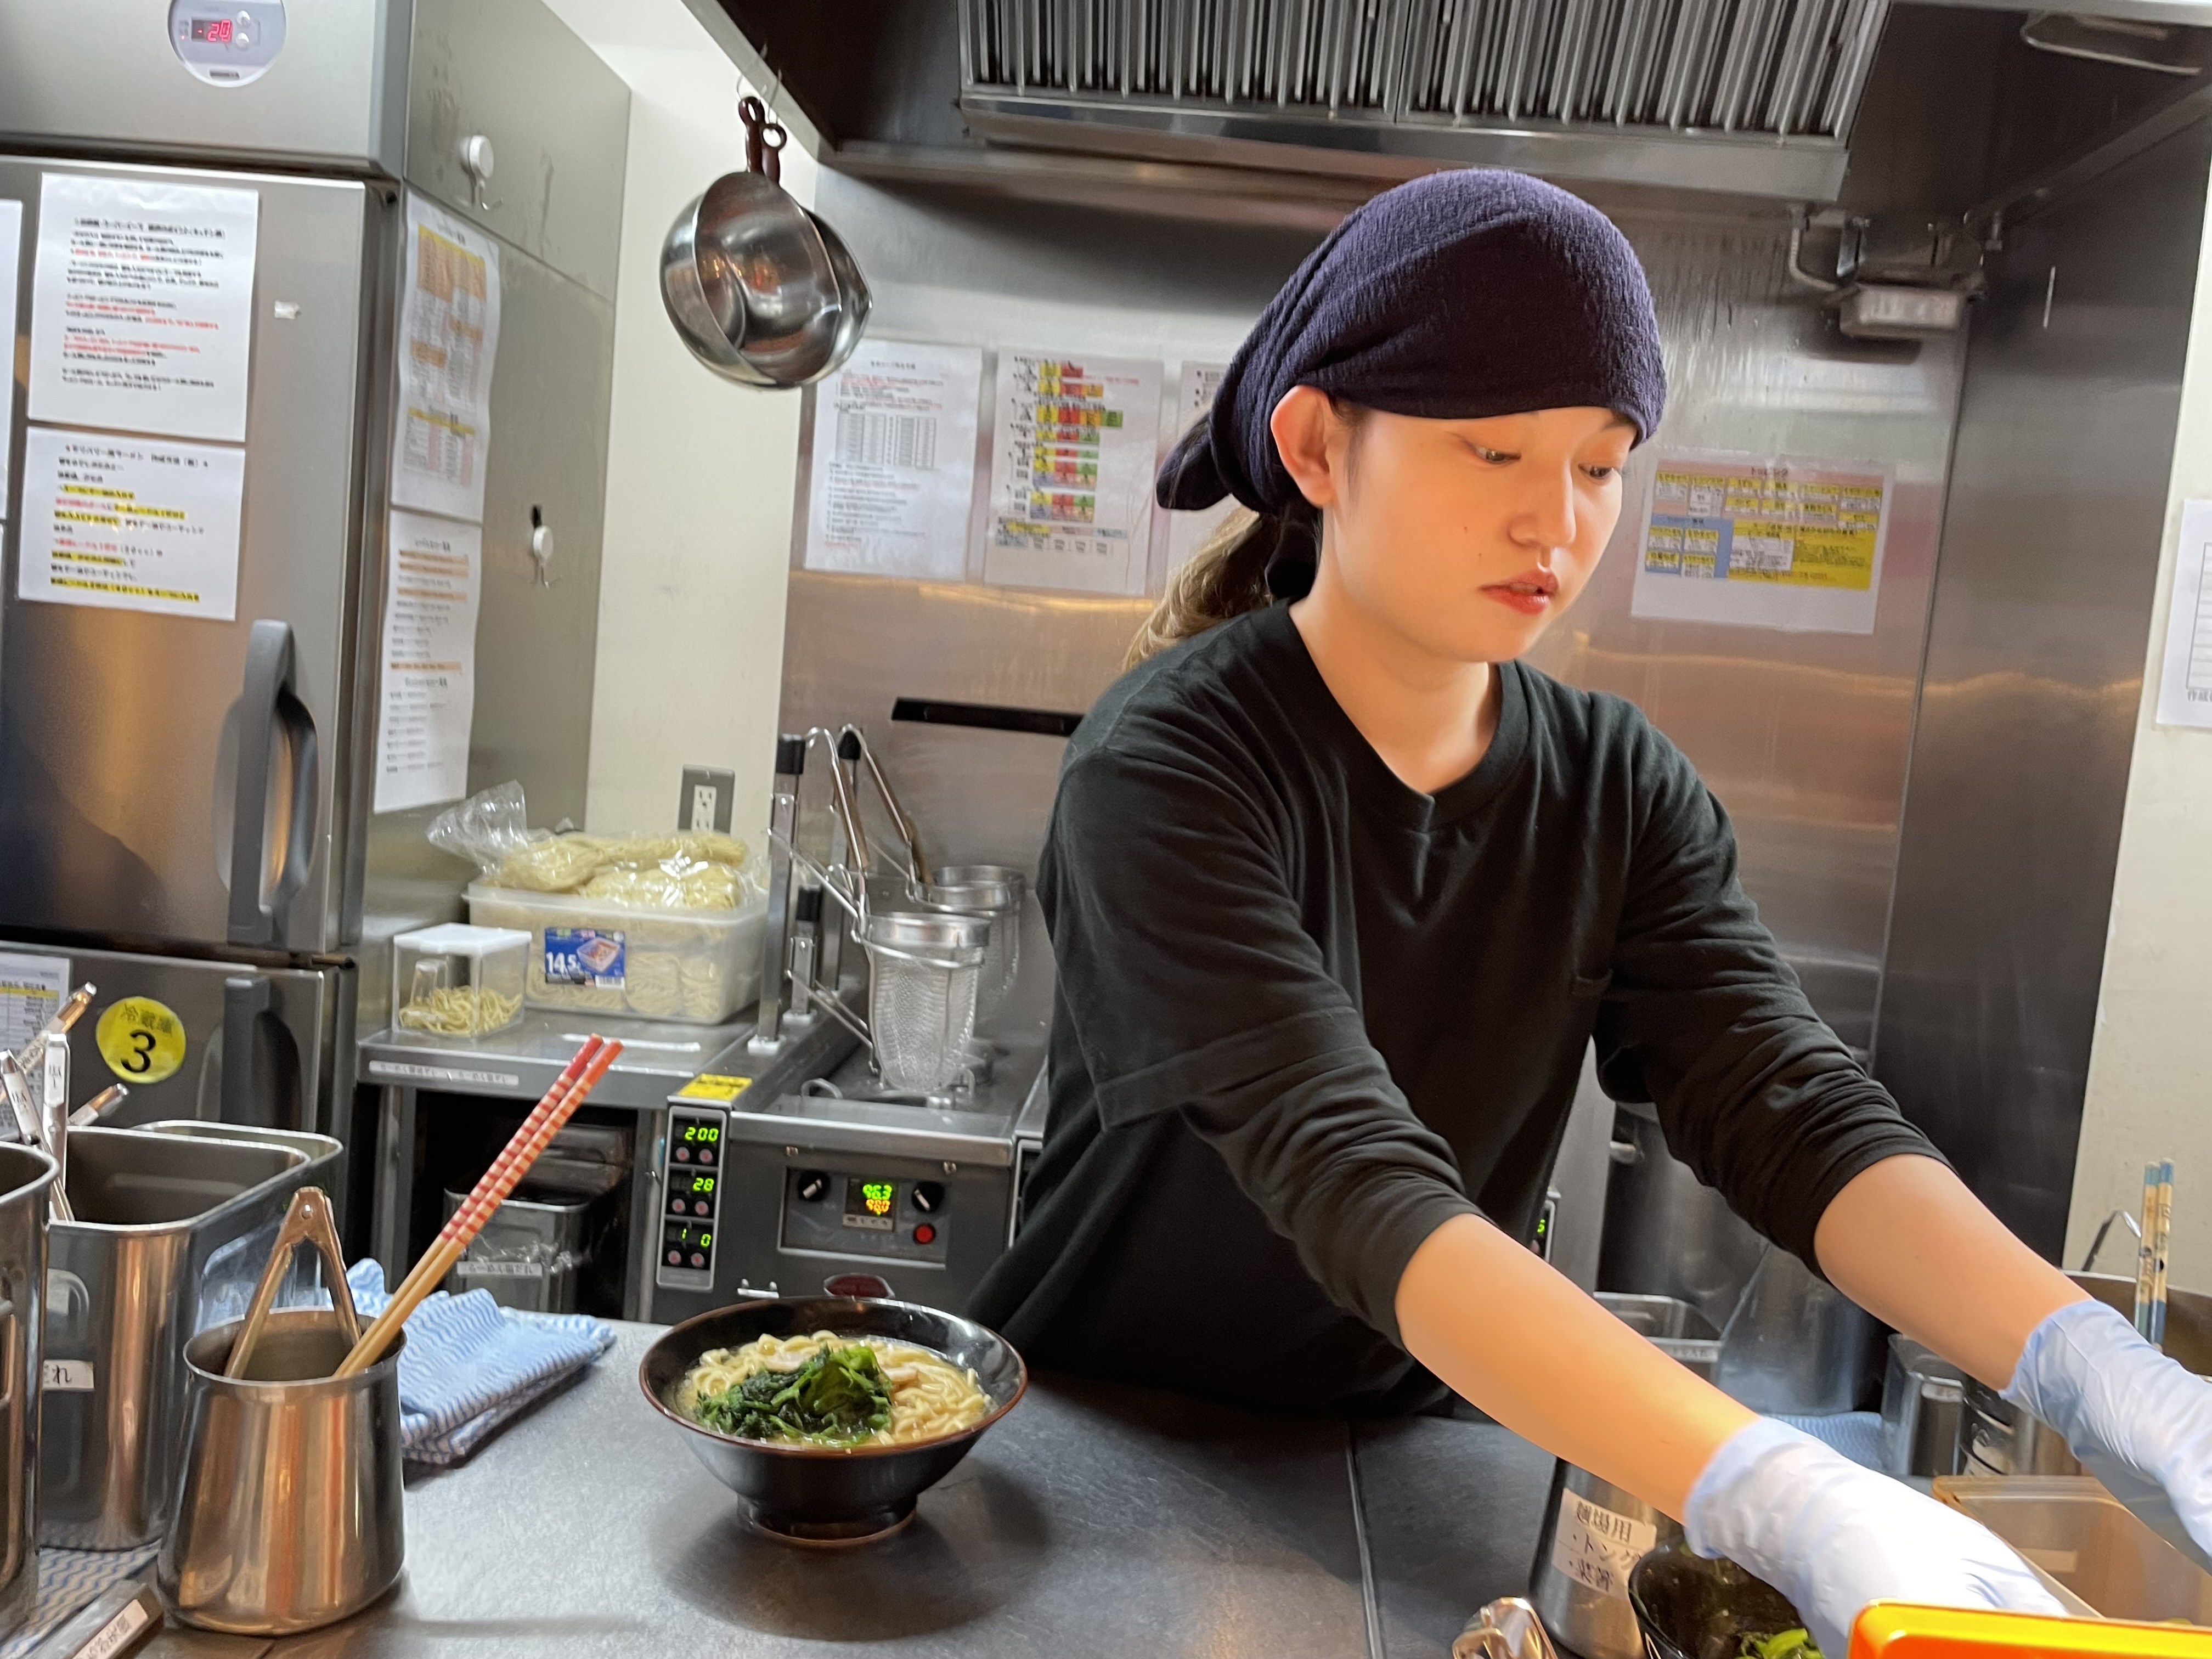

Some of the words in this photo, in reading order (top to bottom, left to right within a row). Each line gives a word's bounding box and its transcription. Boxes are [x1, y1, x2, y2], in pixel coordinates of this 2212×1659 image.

[121, 1029, 156, 1073] 3
[685, 1127, 719, 1142] 200
[693, 1177, 714, 1192] 28
